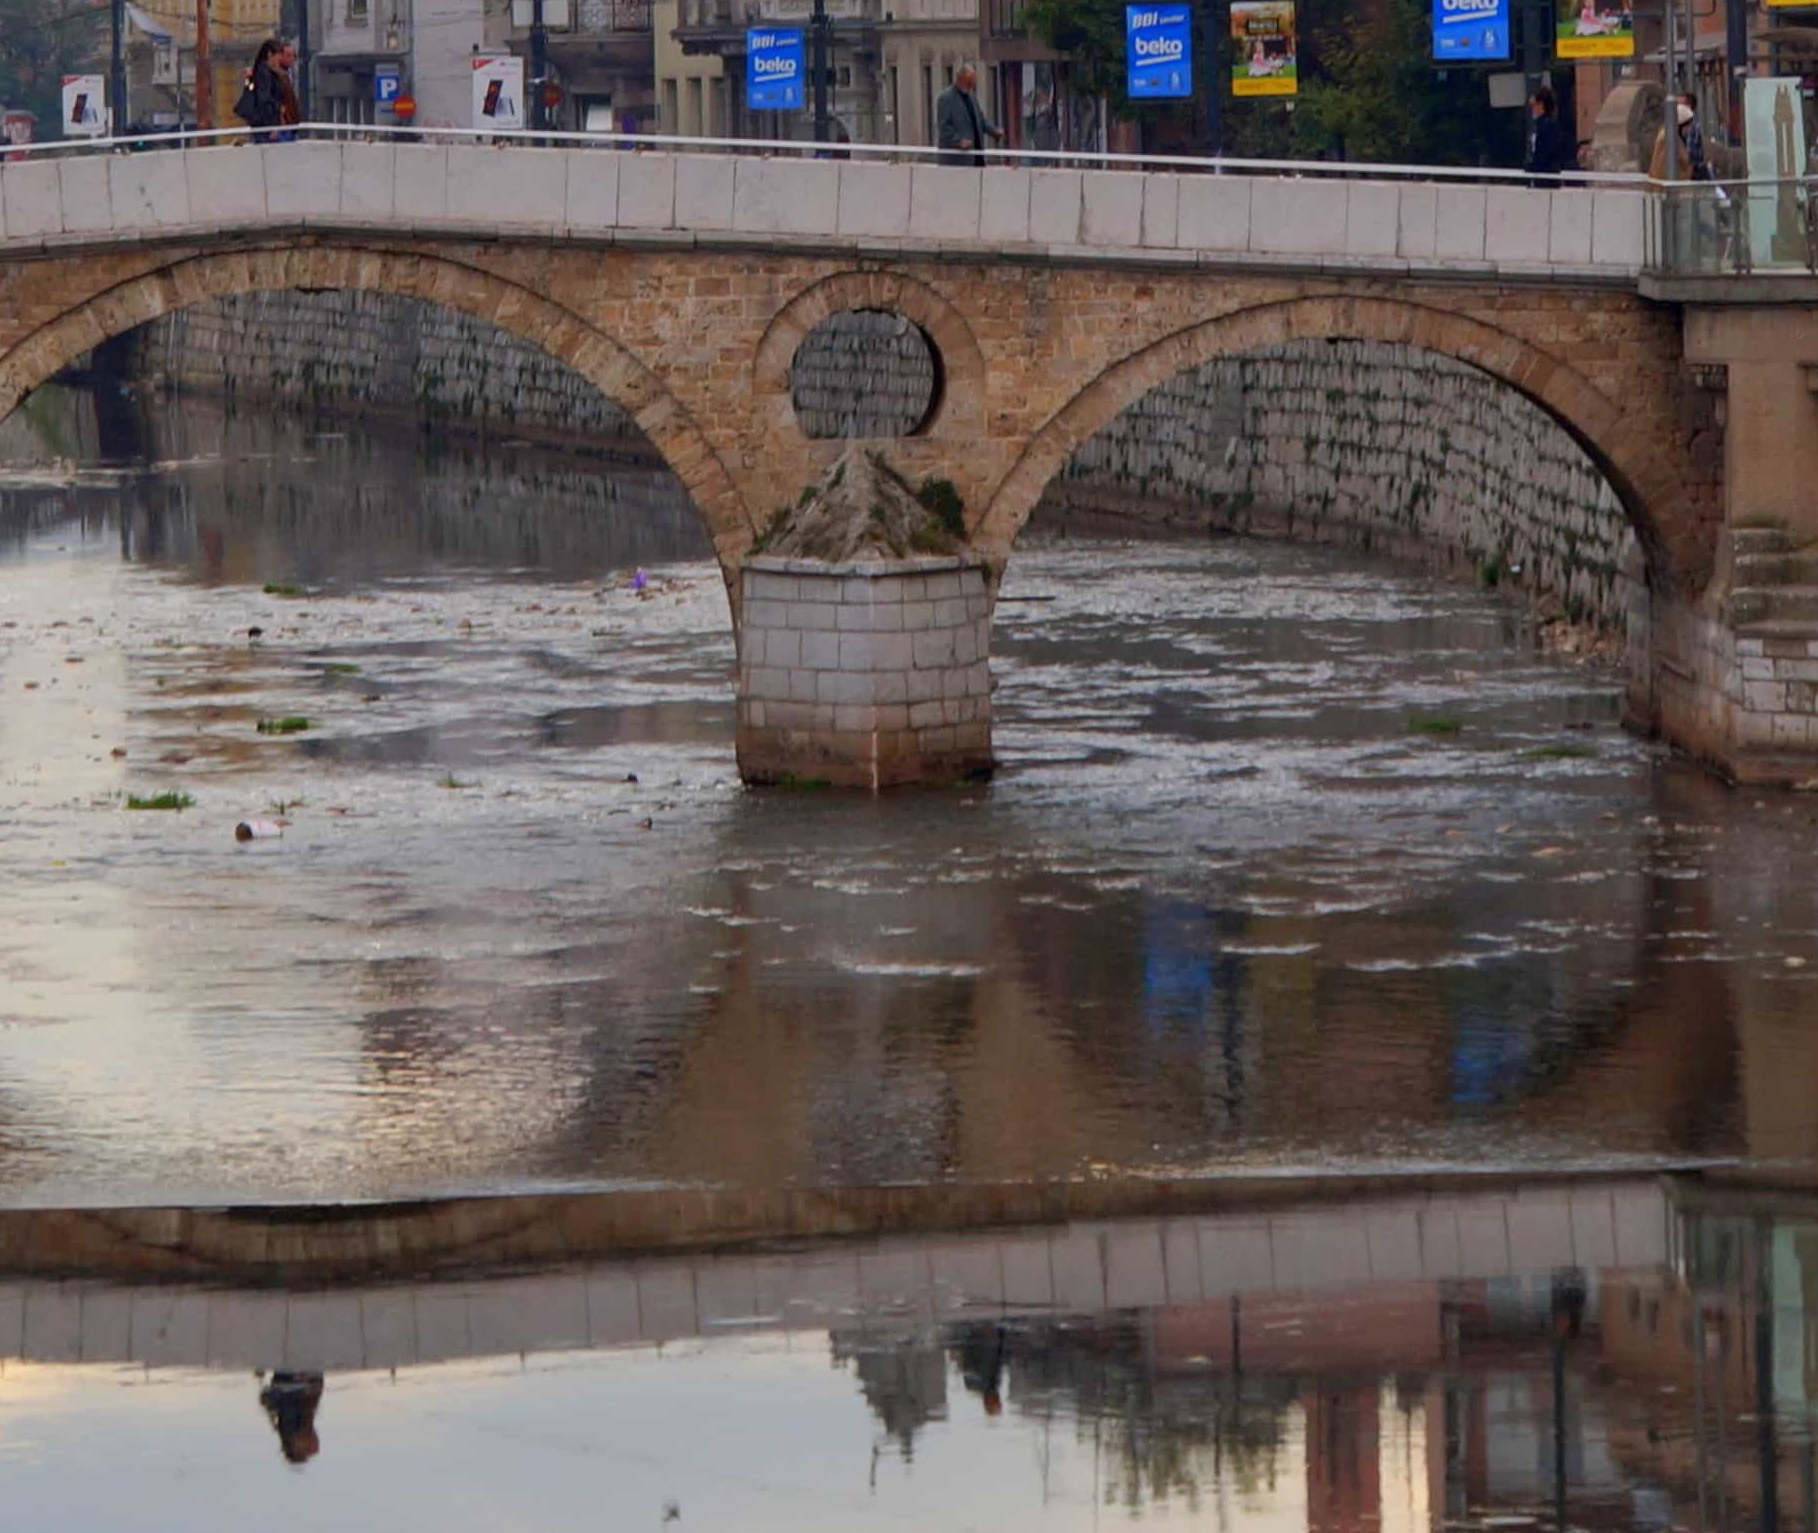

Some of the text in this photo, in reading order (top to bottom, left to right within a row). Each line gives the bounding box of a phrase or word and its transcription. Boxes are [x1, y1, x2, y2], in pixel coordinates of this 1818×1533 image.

[1132, 11, 1158, 29] BBI
[1135, 36, 1183, 55] beko
[754, 55, 797, 73] beko
[381, 78, 398, 98] P
